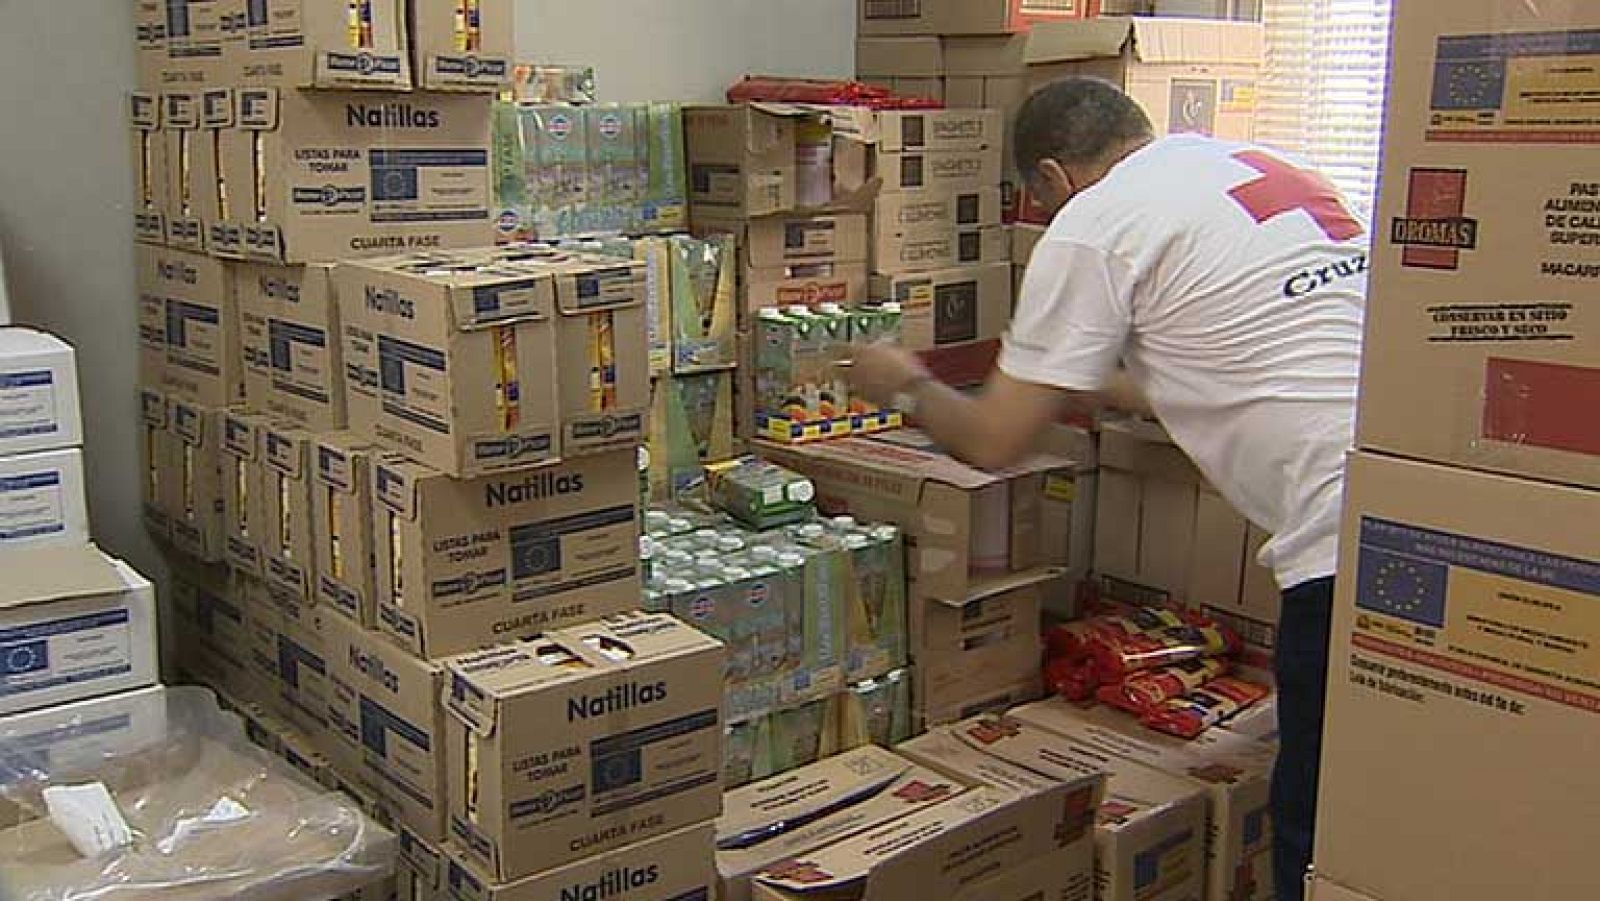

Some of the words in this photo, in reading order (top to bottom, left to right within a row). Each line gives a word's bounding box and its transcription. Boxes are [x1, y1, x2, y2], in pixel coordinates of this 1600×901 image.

[347, 104, 439, 128] Natillas
[351, 237, 403, 250] CUARTA
[406, 235, 441, 248] FASE
[485, 470, 584, 508] Natillas
[567, 679, 668, 723] Natillas
[560, 861, 659, 901] Natillas
